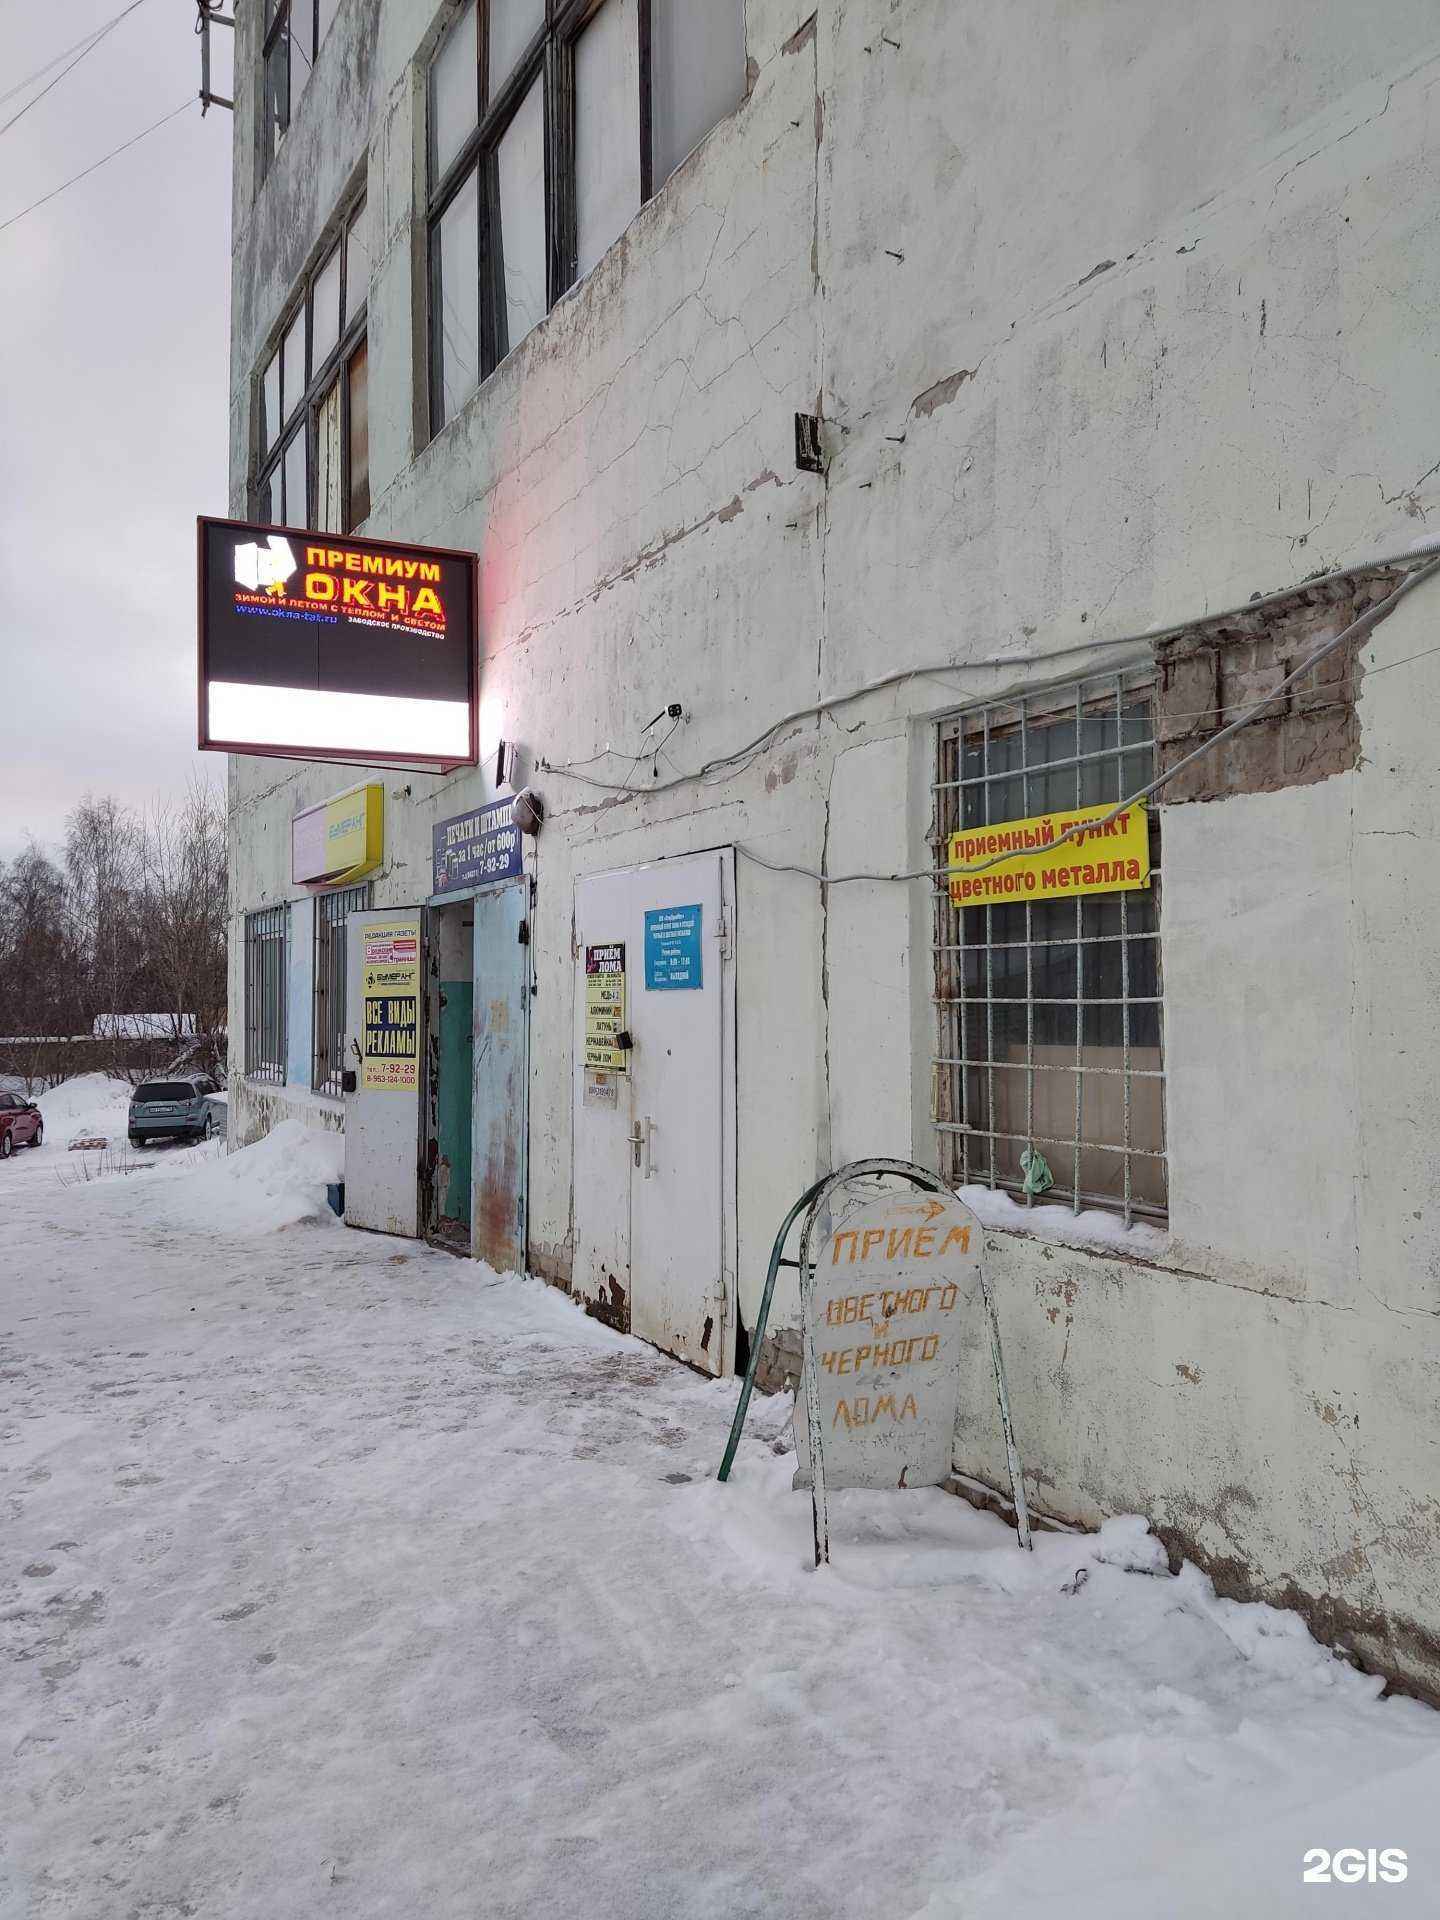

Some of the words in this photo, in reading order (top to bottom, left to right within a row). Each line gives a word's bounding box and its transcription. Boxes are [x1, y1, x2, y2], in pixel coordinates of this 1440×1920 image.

[305, 546, 441, 582] ПРЕМИУМ
[234, 592, 276, 605] ЗИМОЙ
[278, 597, 287, 606] И
[289, 599, 328, 611] ЛЕТОМ
[330, 603, 338, 612] С
[341, 605, 385, 620] ТЕПЛОМ
[390, 613, 400, 622] И
[404, 616, 446, 631] СВЕТОМ
[305, 572, 443, 615] ОКНА
[347, 616, 390, 629] ЗАВОДСКОЕ
[391, 624, 446, 640] ПРОИЗВОДСТВО
[446, 818, 474, 846] ПЕЧАТИ
[474, 815, 480, 837] И
[480, 803, 513, 834] ШТАМП
[954, 818, 1055, 862] приемный
[479, 853, 510, 875] 7-92-29
[950, 870, 1037, 901] цветного
[1042, 858, 1141, 889] металла
[593, 944, 621, 961] ПРИЁМ
[599, 960, 622, 972] ЛОМА
[366, 1000, 383, 1025] ВСЕ
[388, 1000, 416, 1027] ВИДЫ
[366, 1030, 416, 1054] РЕКЛАМЫ
[381, 1063, 416, 1074] 7-92-29
[831, 1225, 971, 1265] ПРИЕМ
[827, 1284, 958, 1326] ЦВЕТНОГО
[821, 1334, 940, 1376] ЧЕРНОГО
[832, 1392, 918, 1431] ЛОМА
